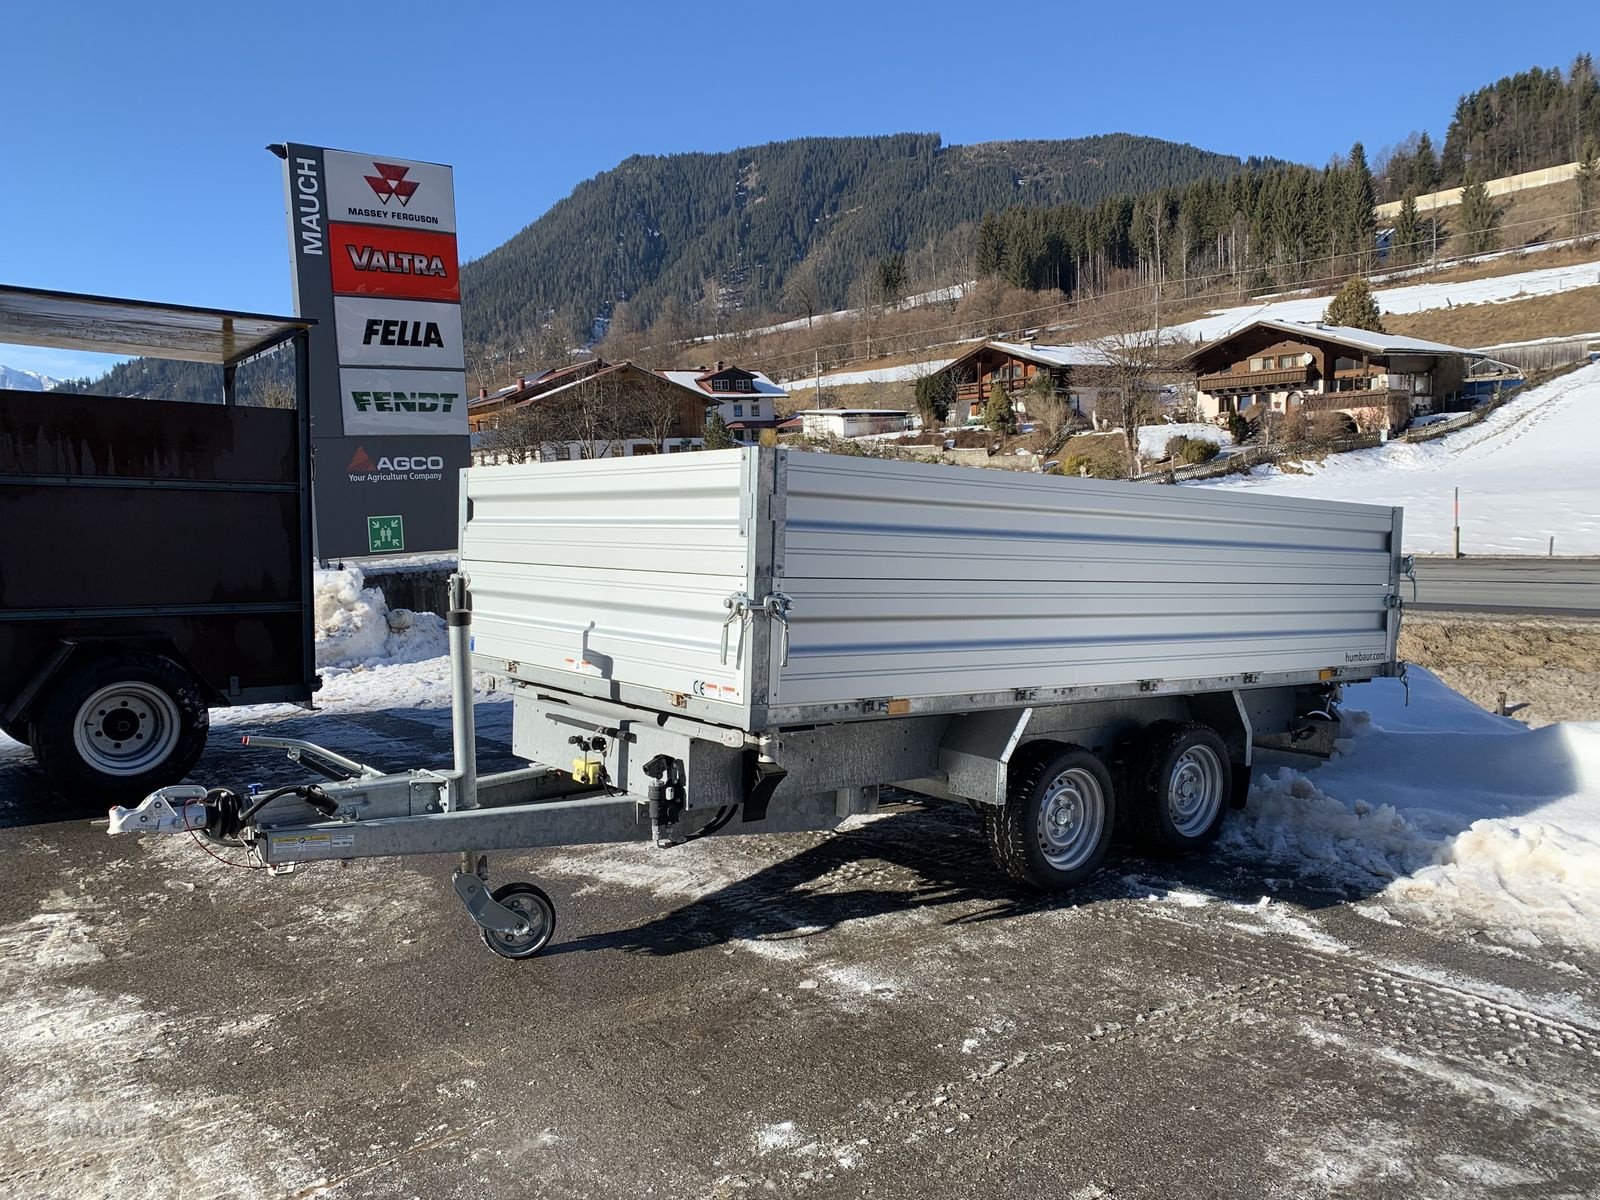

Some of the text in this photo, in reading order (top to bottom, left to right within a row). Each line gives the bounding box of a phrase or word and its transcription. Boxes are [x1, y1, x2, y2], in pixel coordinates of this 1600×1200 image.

[296, 157, 323, 255] MAUCH
[348, 207, 439, 224] MASSEY FERGUSON
[345, 244, 448, 278] VALTRA
[362, 318, 445, 348] FELLA
[351, 391, 459, 413] FENDT
[376, 456, 444, 471] AGCO
[349, 472, 442, 483] Your Agriculture Company
[1345, 652, 1385, 662] humbaur.com
